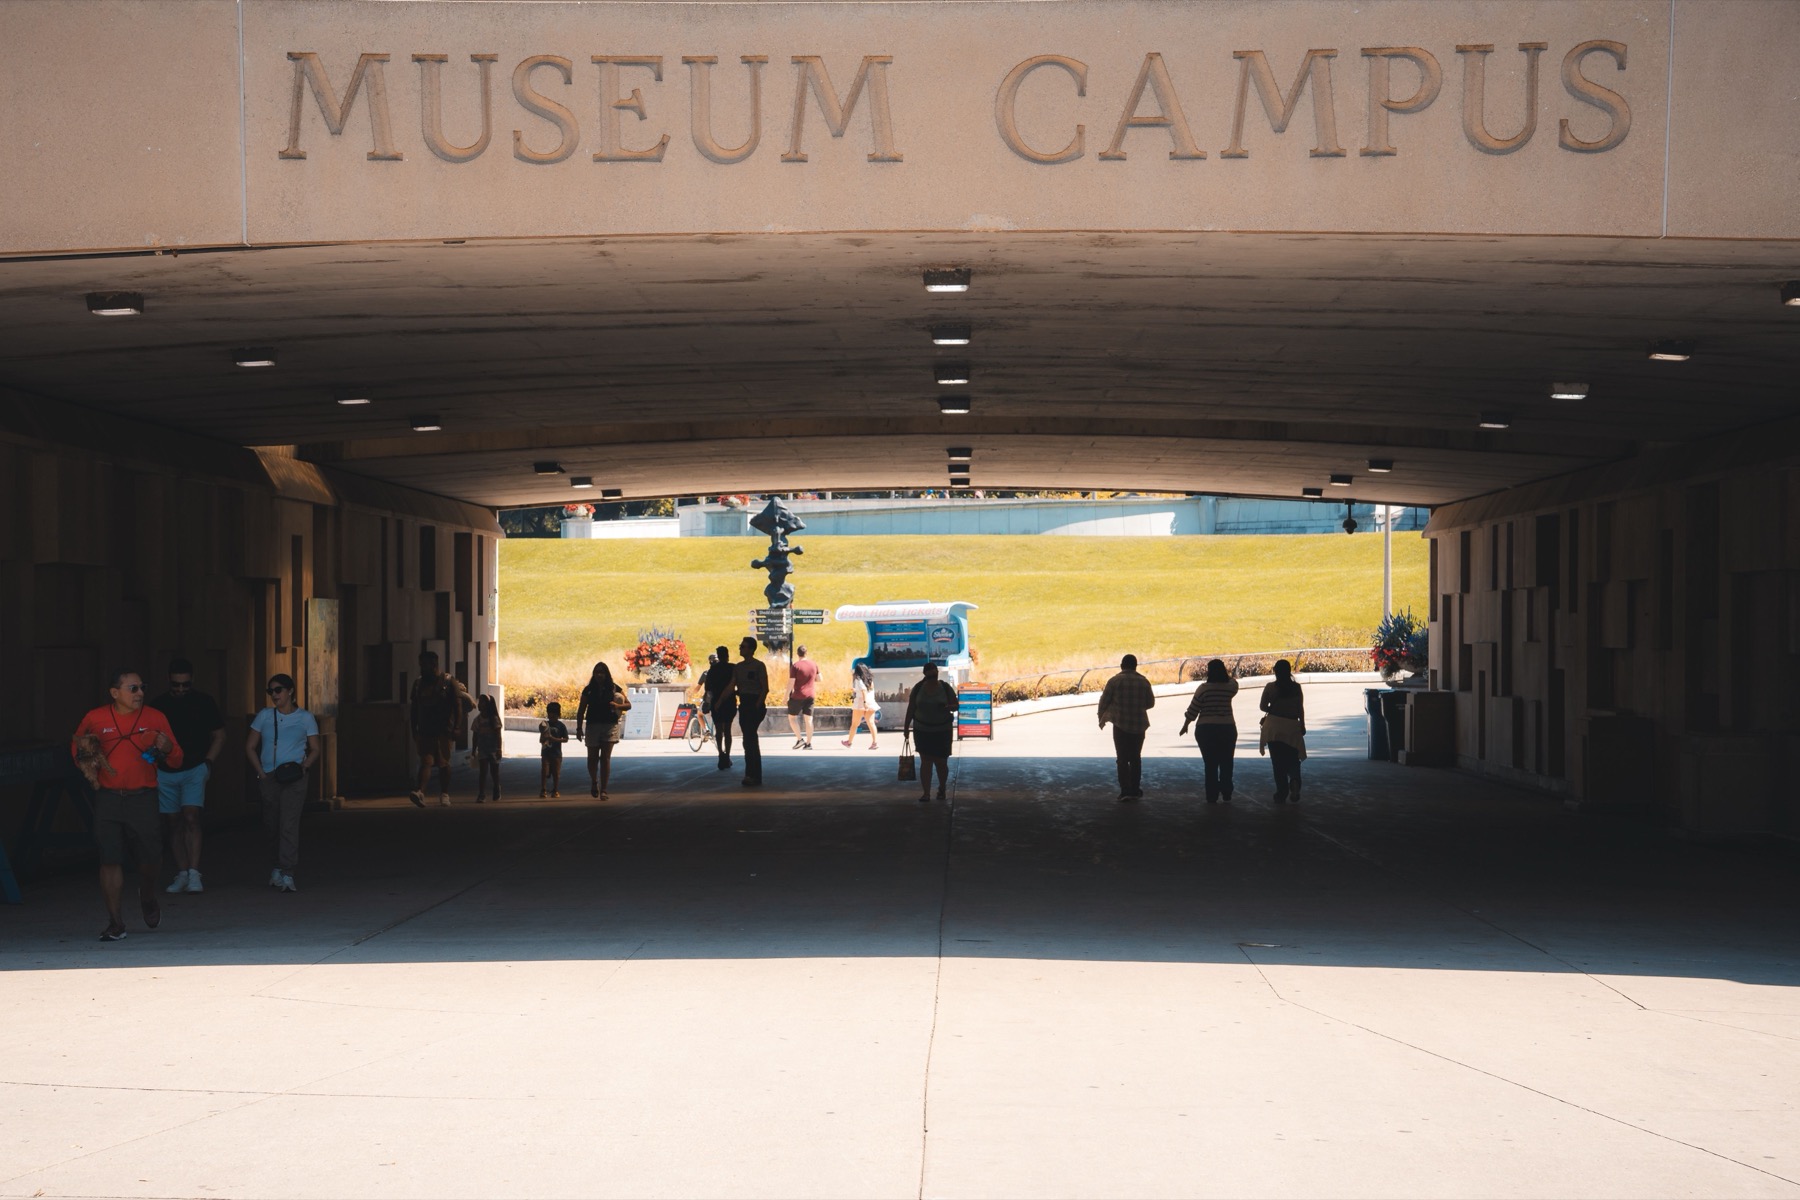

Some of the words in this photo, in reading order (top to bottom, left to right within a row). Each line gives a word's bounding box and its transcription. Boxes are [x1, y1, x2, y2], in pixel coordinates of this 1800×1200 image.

[278, 50, 904, 165] MUSEUM
[993, 38, 1632, 166] CAMPUS
[840, 610, 867, 619] Boat
[870, 609, 897, 618] Ride
[902, 607, 944, 617] Tickets
